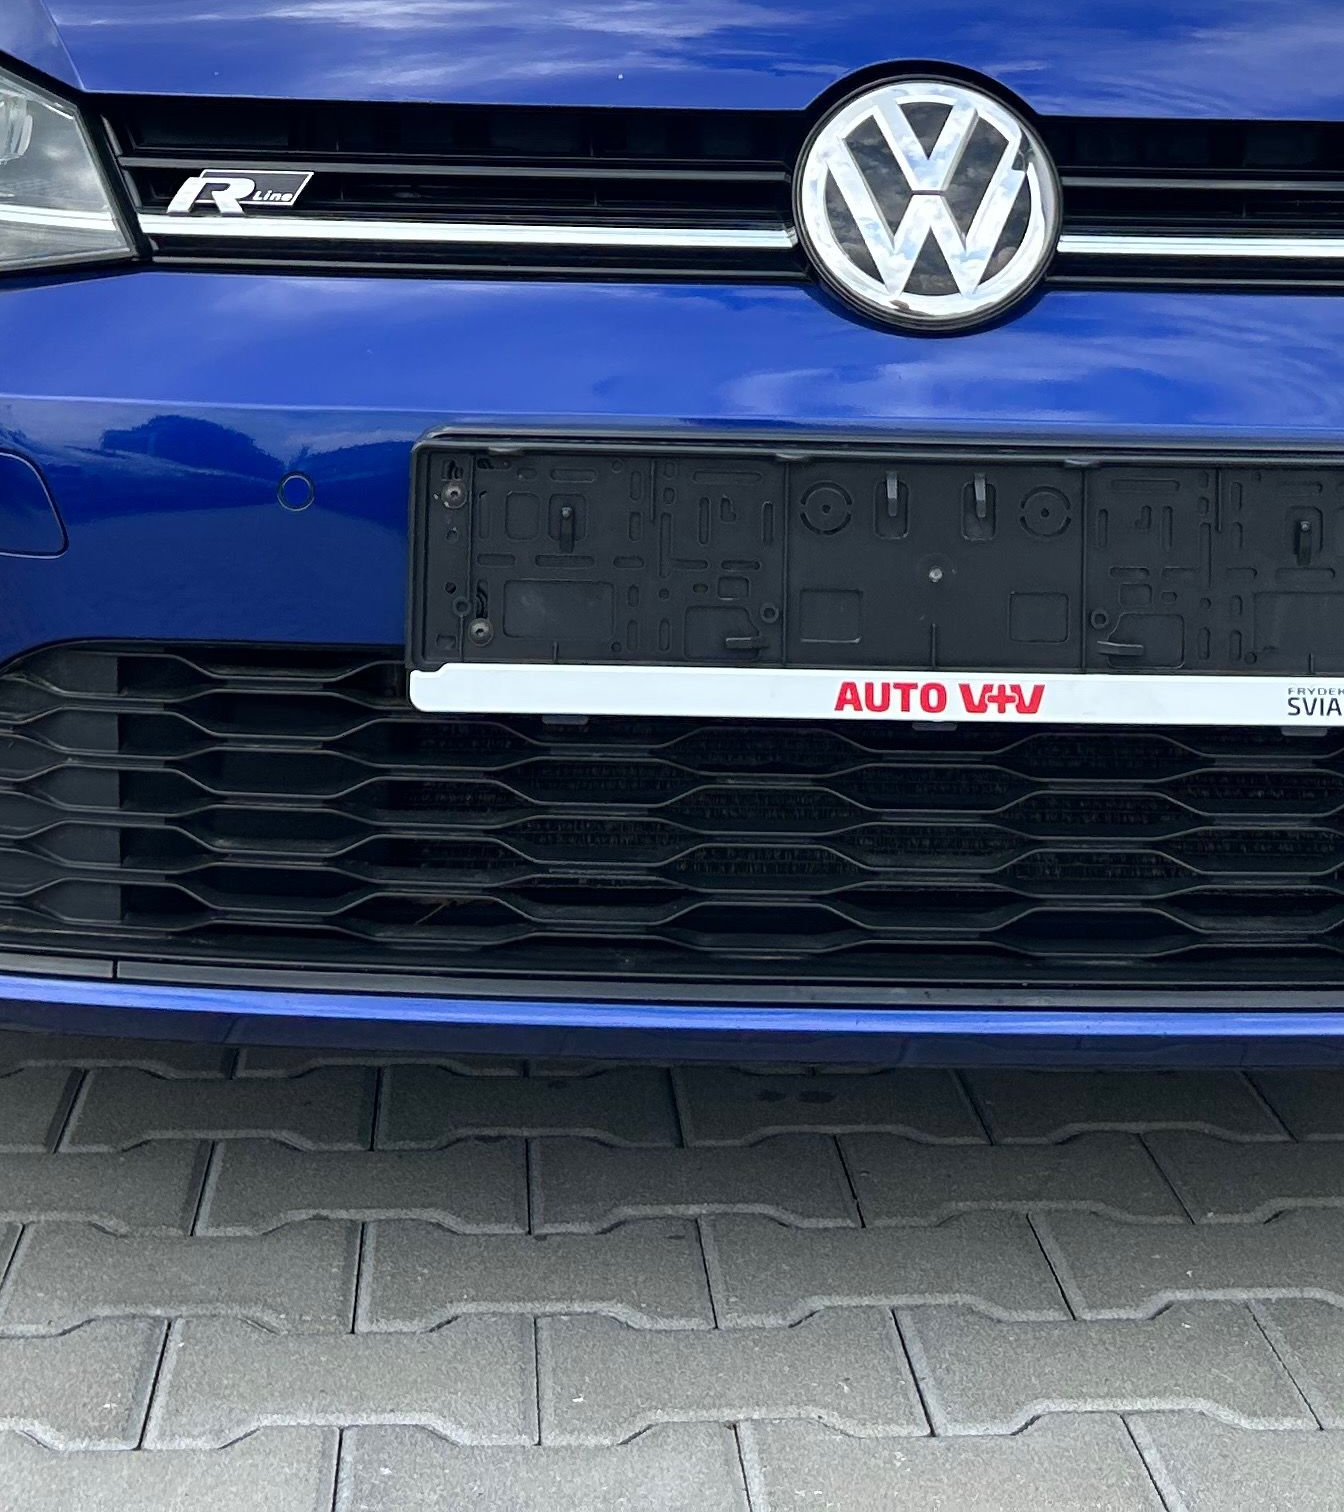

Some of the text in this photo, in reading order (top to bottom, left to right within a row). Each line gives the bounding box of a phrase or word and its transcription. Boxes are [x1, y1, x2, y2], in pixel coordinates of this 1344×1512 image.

[166, 176, 256, 217] R
[834, 681, 1046, 714] AUTO V+V
